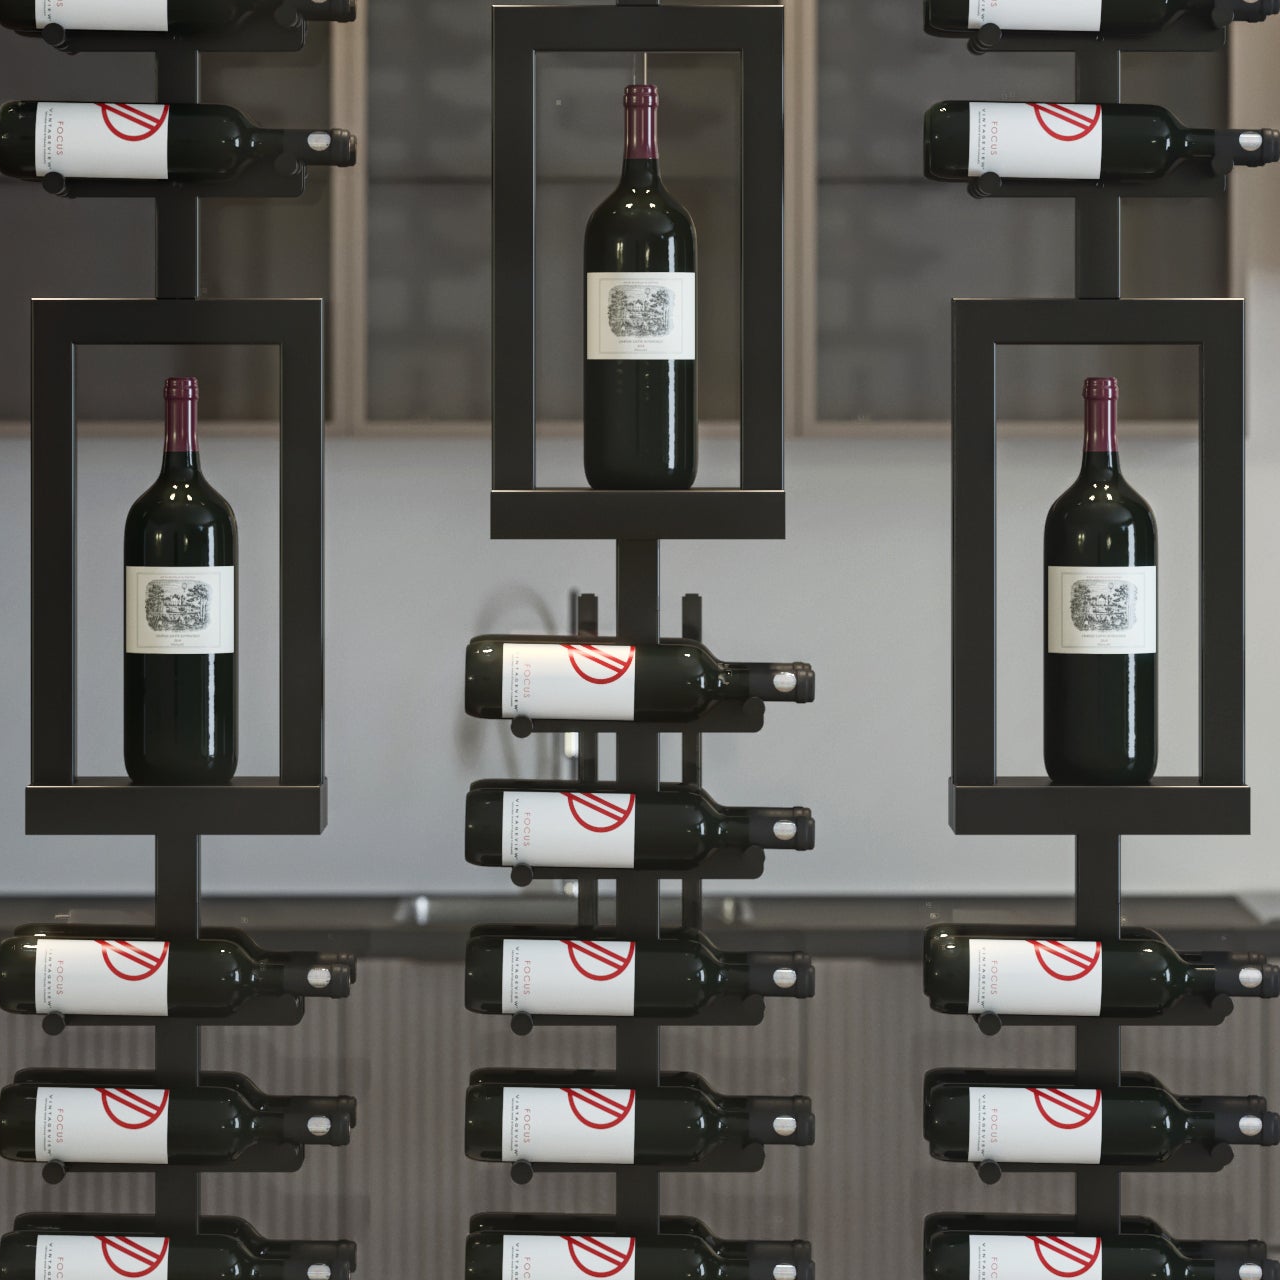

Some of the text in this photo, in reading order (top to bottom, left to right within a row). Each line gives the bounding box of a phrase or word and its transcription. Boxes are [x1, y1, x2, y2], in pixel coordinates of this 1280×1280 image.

[990, 121, 998, 156] FOCUS
[523, 812, 531, 847] FOCUS
[523, 960, 531, 995] FOCUS
[990, 960, 998, 995] FOCUS
[523, 1108, 531, 1143] FOCUS
[990, 1108, 998, 1143] FOCUS
